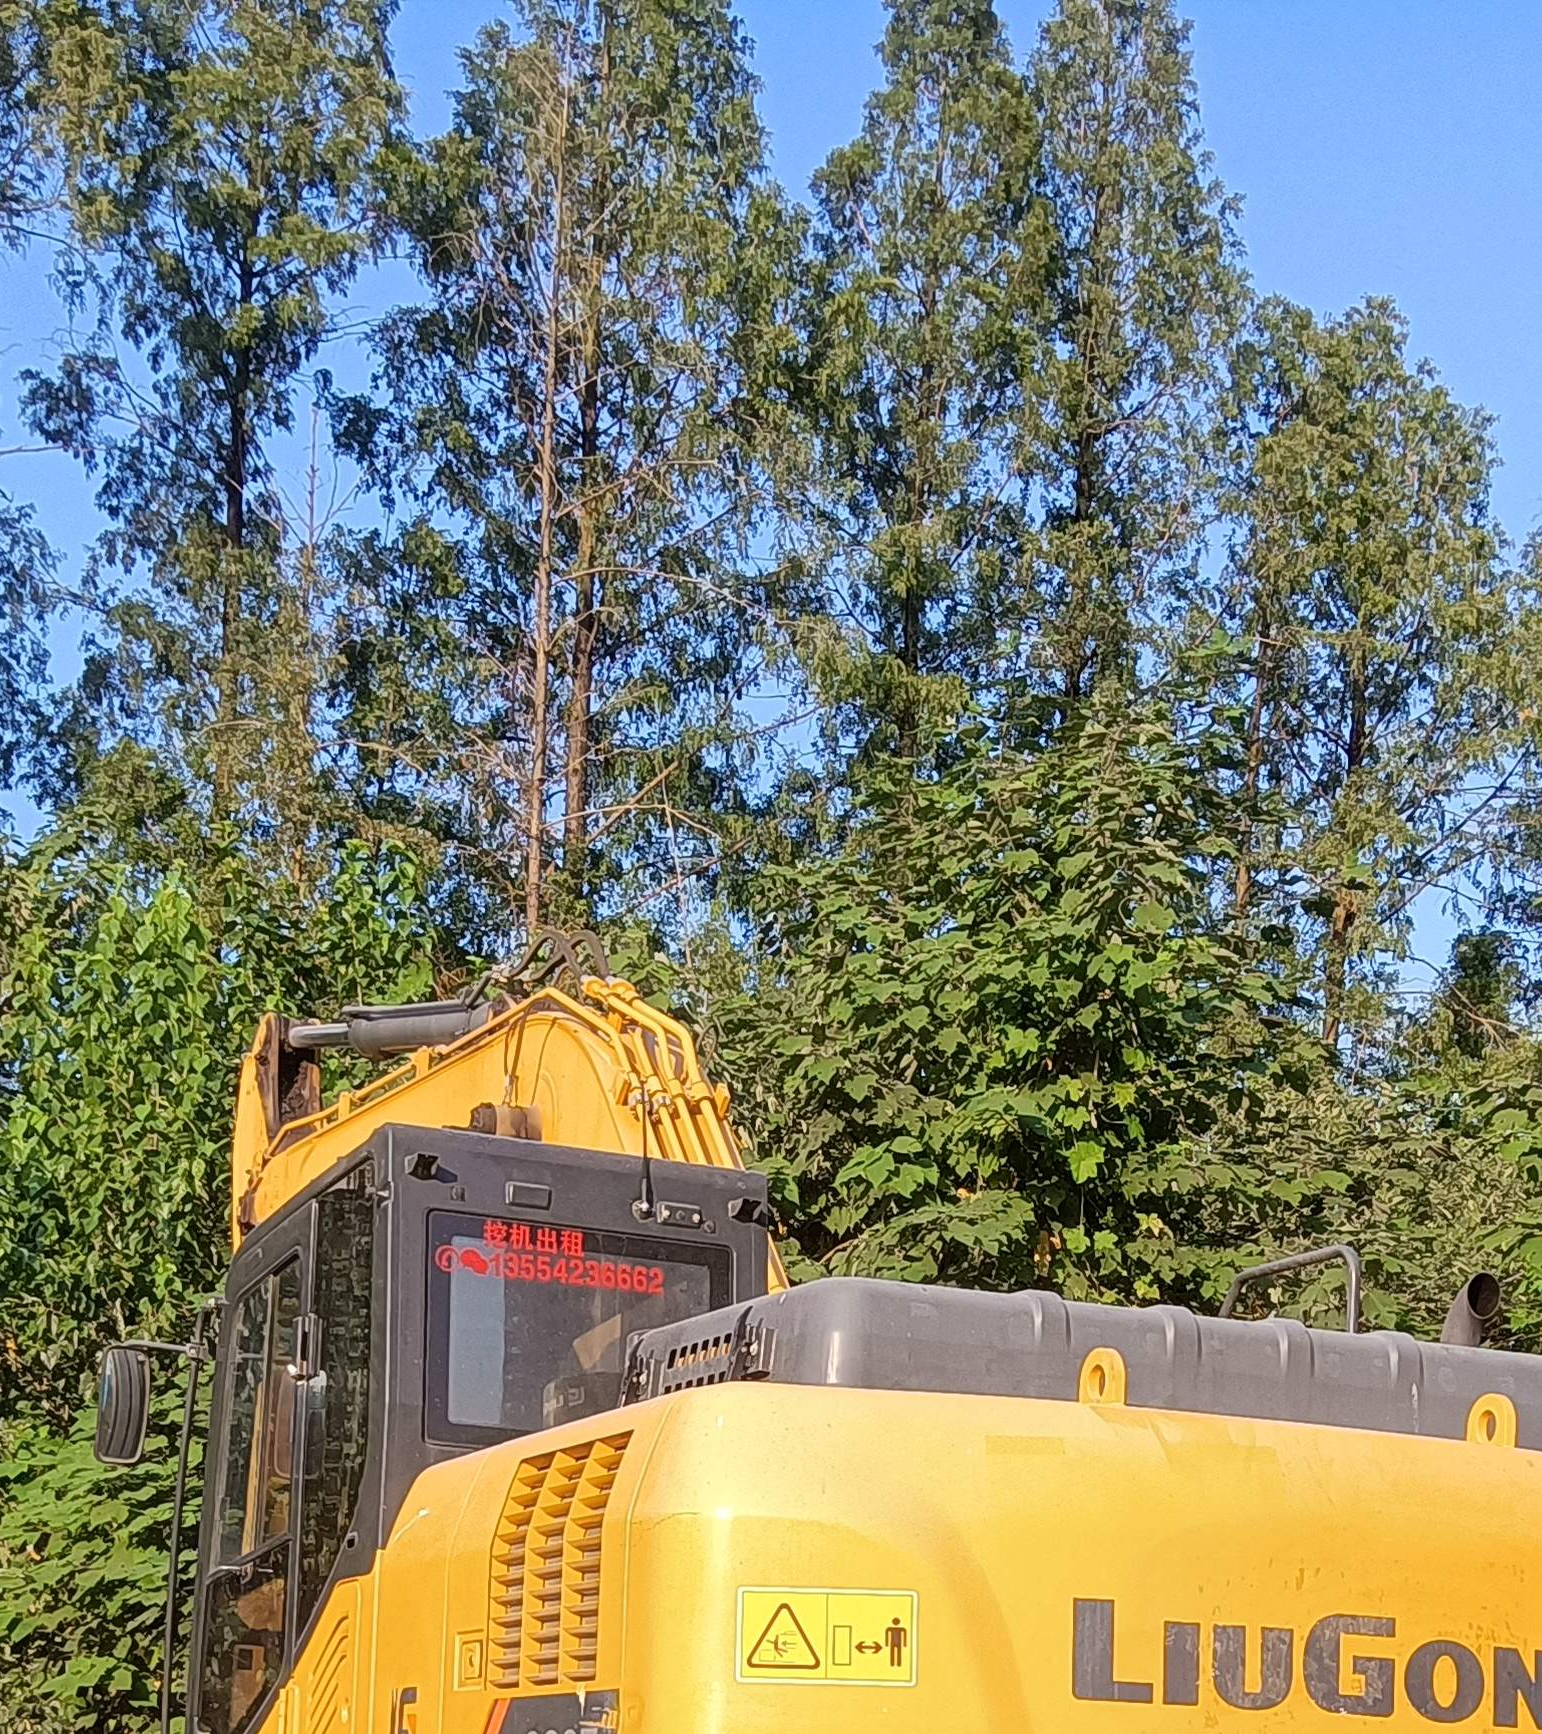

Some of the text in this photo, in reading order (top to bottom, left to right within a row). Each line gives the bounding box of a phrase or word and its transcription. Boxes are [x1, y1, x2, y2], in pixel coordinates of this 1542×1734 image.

[483, 1220, 585, 1257] 挖机出租
[491, 1252, 664, 1296] 13554236662
